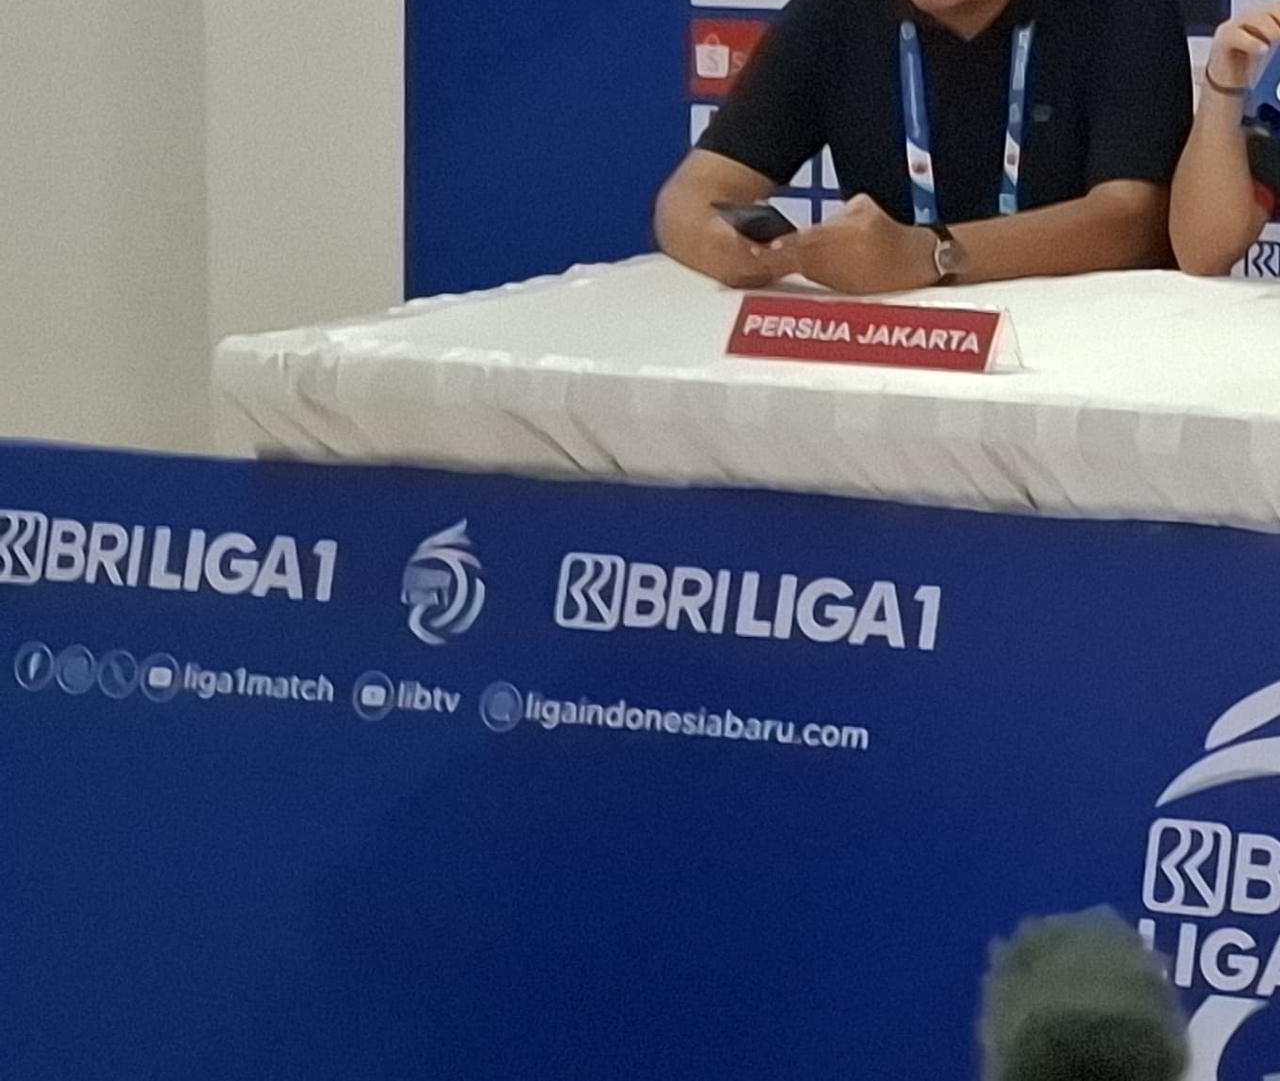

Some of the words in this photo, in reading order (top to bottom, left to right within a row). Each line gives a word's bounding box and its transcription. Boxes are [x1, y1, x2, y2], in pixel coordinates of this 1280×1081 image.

[744, 315, 850, 342] PERSIJA
[857, 324, 979, 353] JAKARTA
[46, 518, 145, 587] BRI
[149, 526, 303, 600] LIGA
[312, 540, 337, 601] 1
[623, 562, 730, 634] BRI
[736, 571, 905, 648] LIGA
[914, 585, 941, 651] 1
[184, 662, 334, 703] liga1match
[398, 681, 461, 714] libtv
[525, 691, 868, 749] ligaindonesiabaru.com
